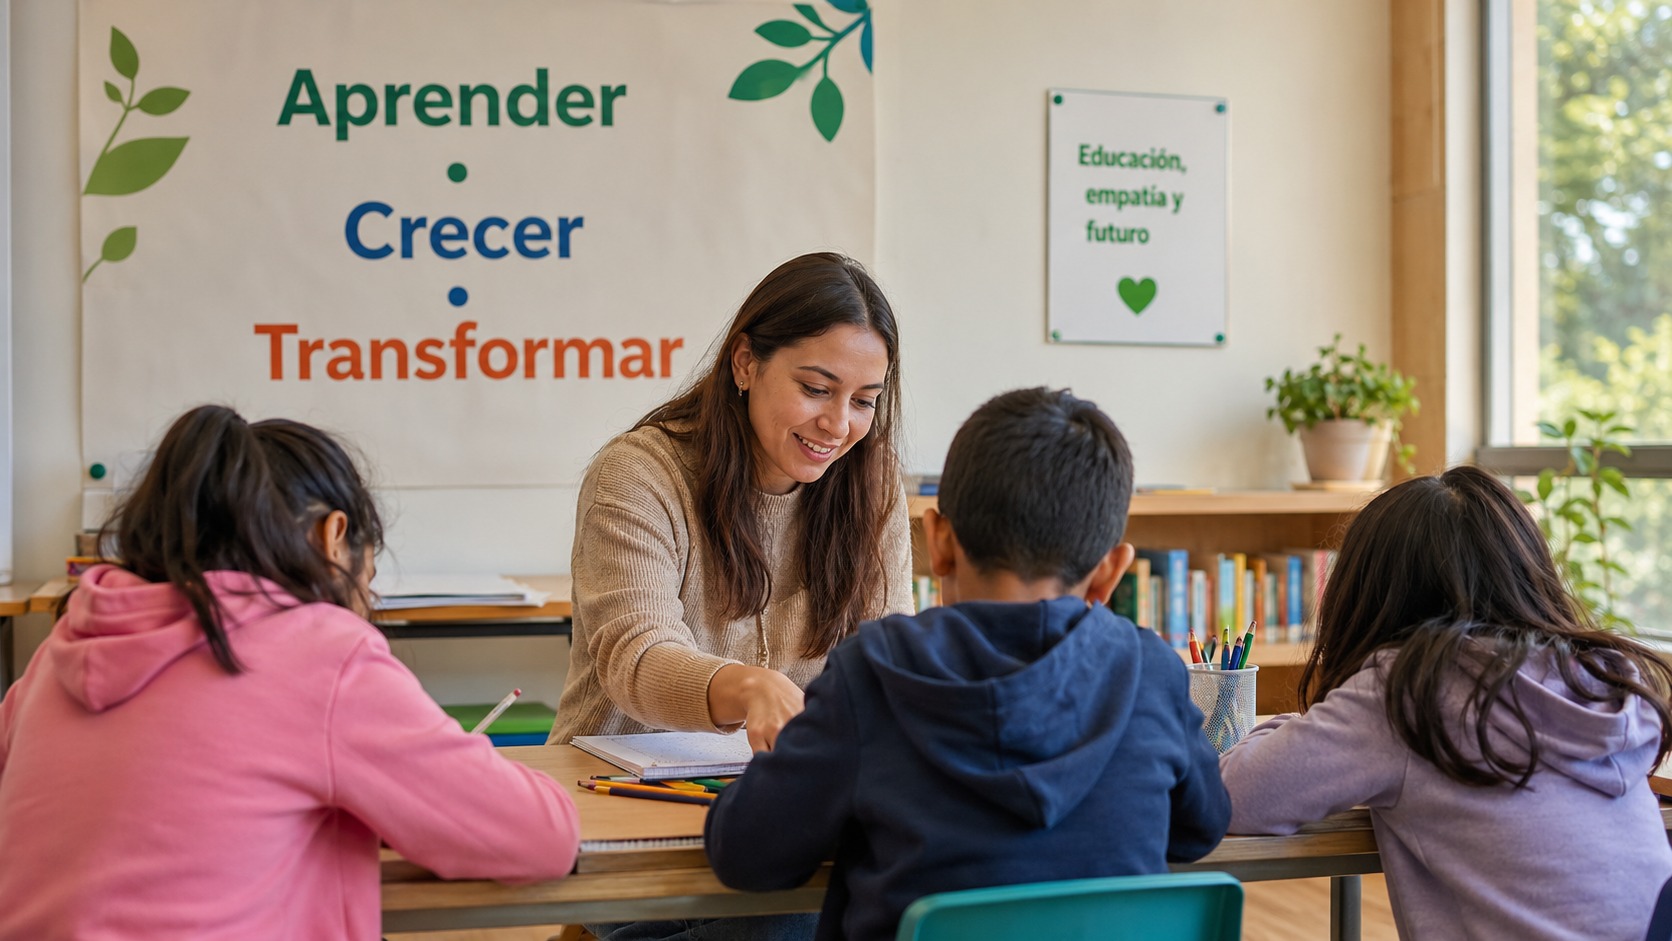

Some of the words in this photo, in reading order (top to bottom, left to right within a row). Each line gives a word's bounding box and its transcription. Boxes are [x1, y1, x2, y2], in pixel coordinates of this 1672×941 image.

[277, 68, 627, 141] Aprender
[1078, 143, 1187, 173] Educación,
[1085, 184, 1167, 211] empatía
[1172, 191, 1184, 214] y
[345, 201, 584, 260] Crecer
[1085, 219, 1150, 244] futuro
[253, 321, 684, 381] Transformar
